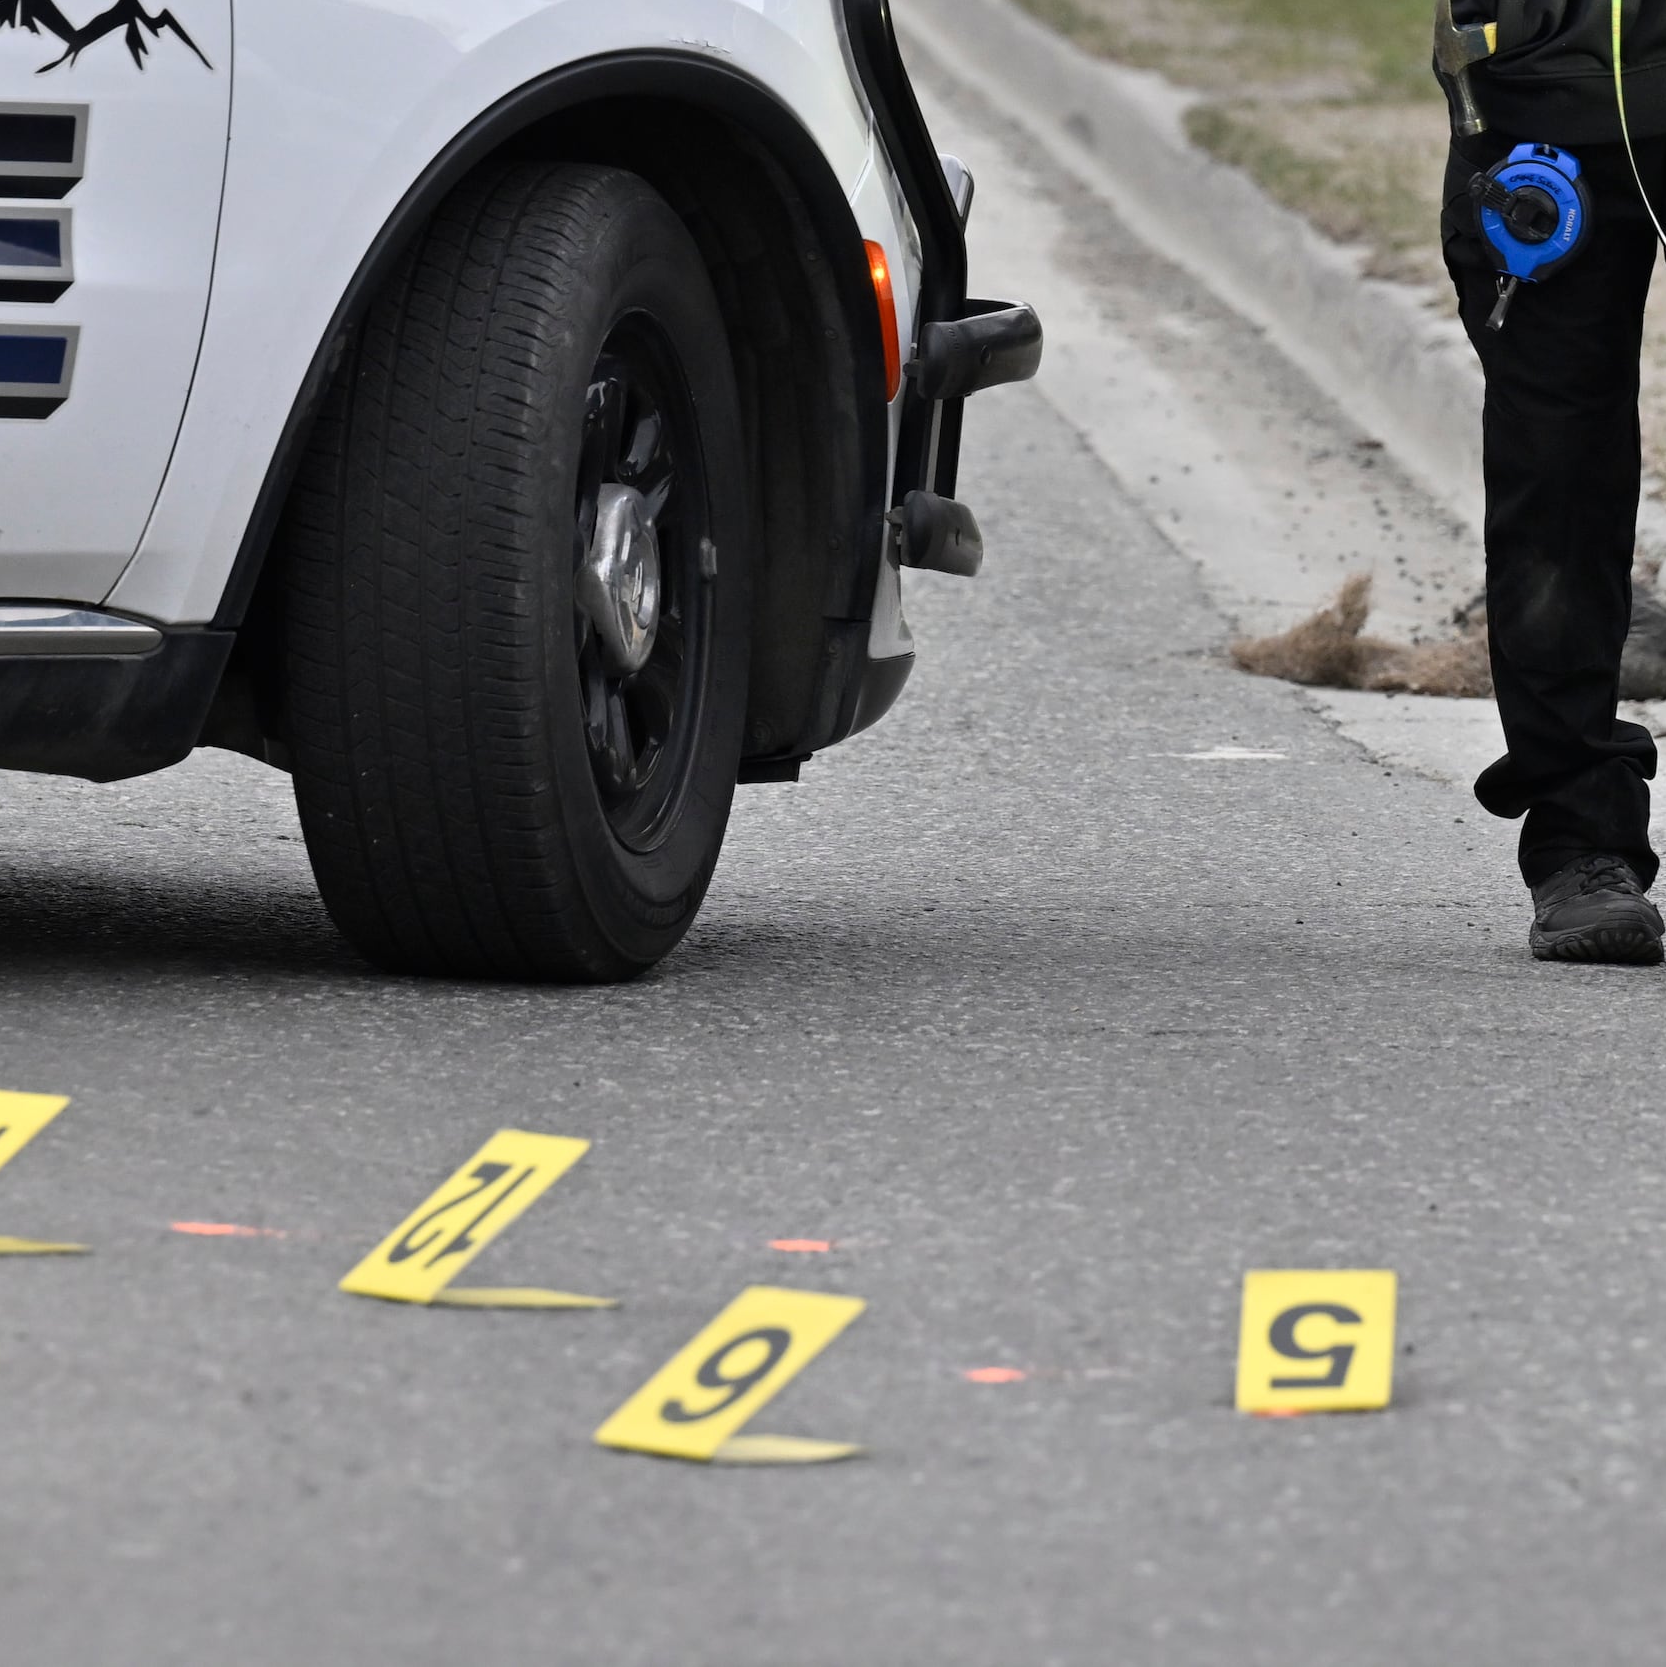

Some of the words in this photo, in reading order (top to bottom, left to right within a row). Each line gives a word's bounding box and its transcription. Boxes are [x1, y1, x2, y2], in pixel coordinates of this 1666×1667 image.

[1563, 208, 1576, 242] KOBALT
[387, 1161, 538, 1271] 12
[1268, 1302, 1364, 1388] 5
